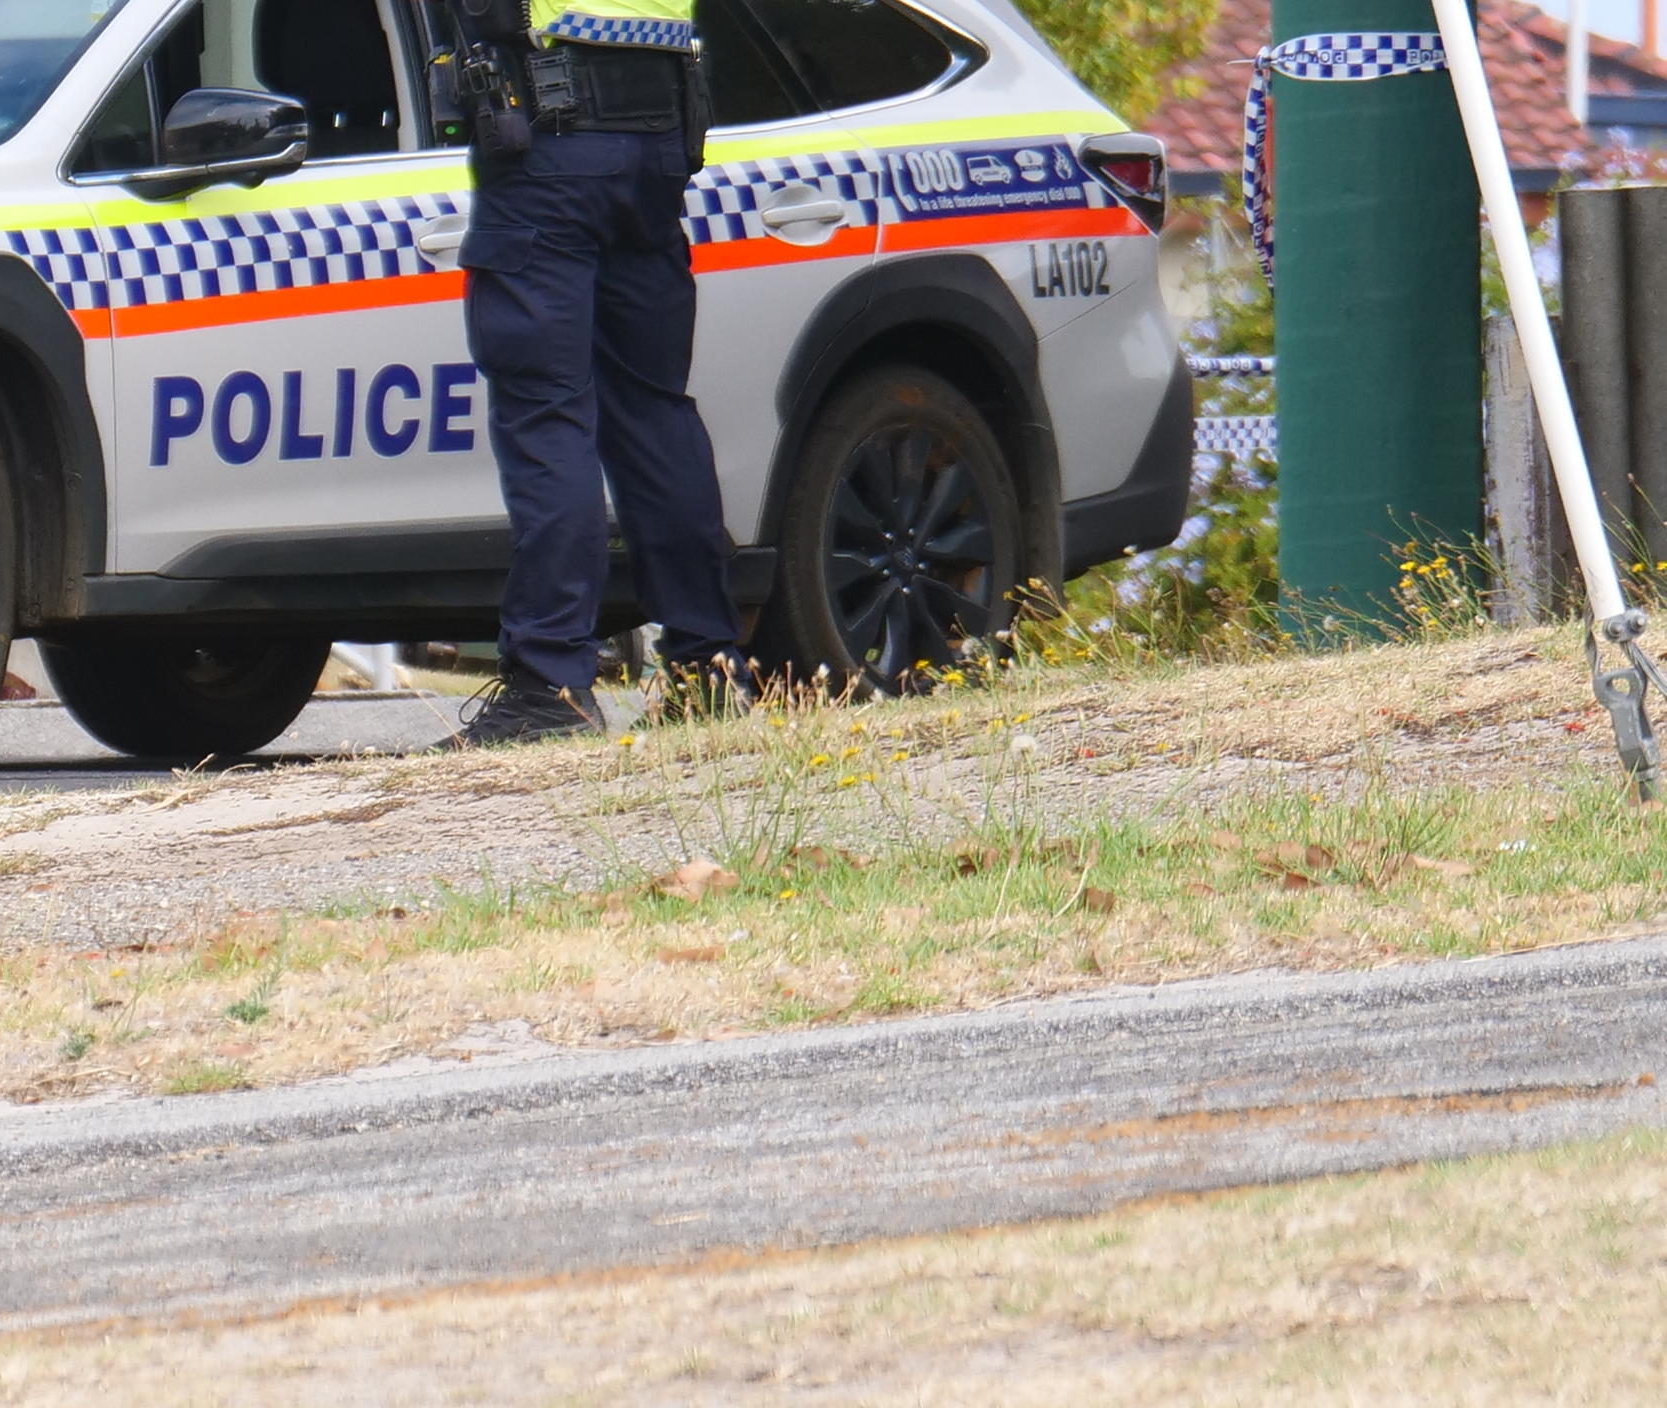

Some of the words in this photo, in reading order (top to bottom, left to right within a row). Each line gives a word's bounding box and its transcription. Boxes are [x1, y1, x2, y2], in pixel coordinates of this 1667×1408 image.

[904, 148, 966, 194] 000
[931, 199, 939, 210] a
[937, 196, 955, 210] life
[953, 192, 1004, 208] threatening
[1003, 190, 1049, 205] emergency
[1049, 187, 1066, 201] dial
[1065, 186, 1082, 200] 000
[1027, 241, 1110, 298] LA102
[149, 361, 478, 467] POLICE
